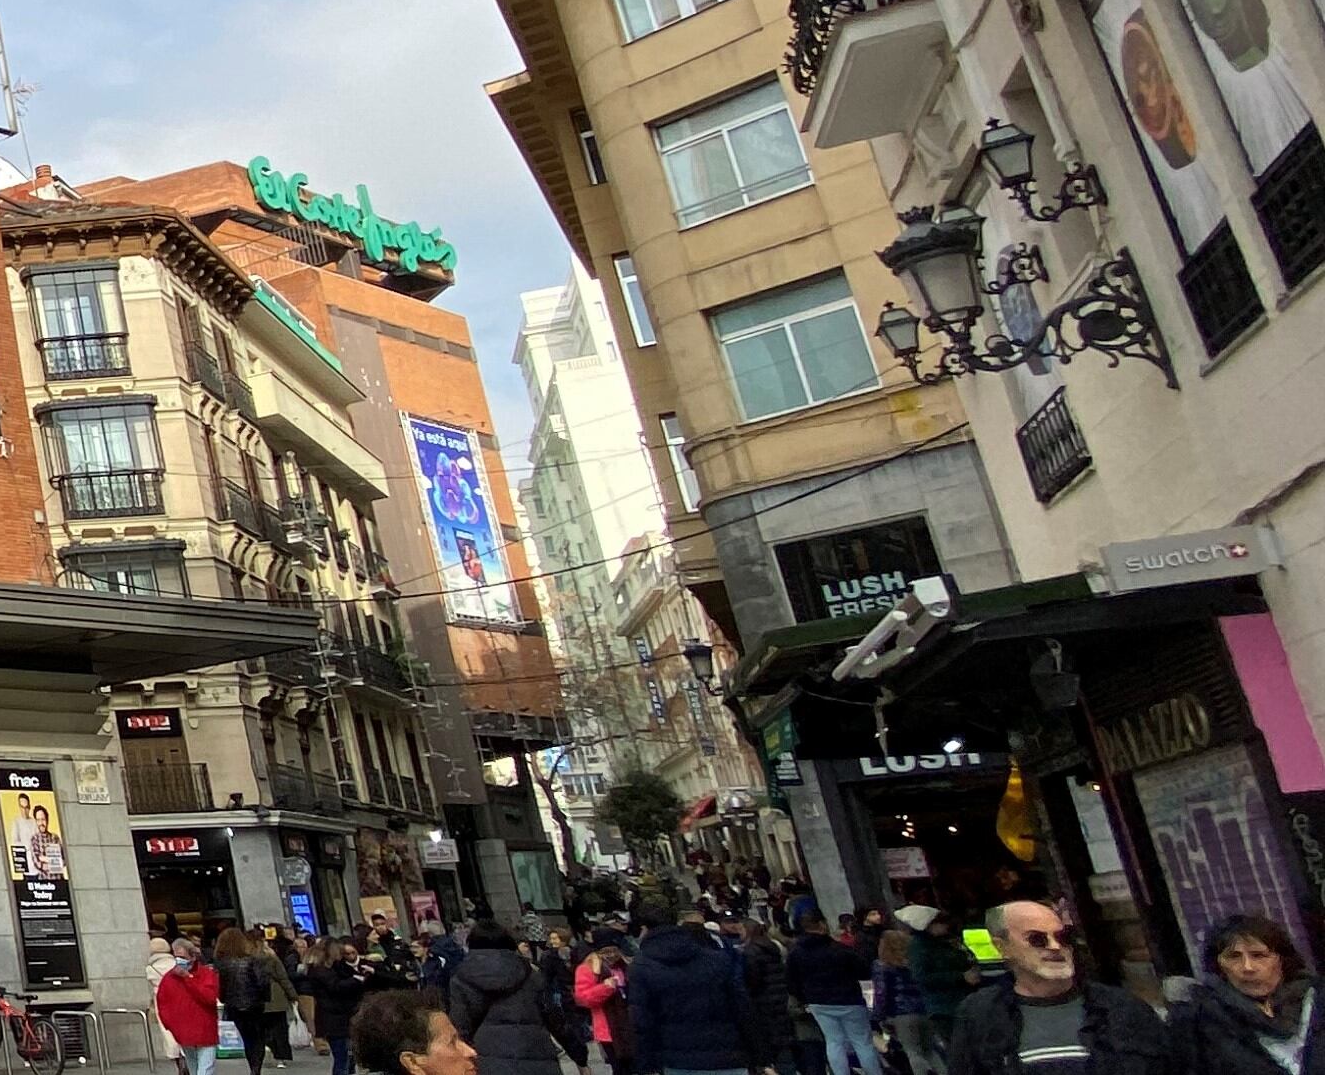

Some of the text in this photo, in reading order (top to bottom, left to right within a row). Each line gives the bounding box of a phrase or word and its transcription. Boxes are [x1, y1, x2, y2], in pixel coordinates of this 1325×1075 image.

[412, 427, 468, 453] Ya está aquí
[1125, 543, 1231, 574] swatch
[822, 570, 906, 603] LUSH
[9, 773, 40, 788] fnac
